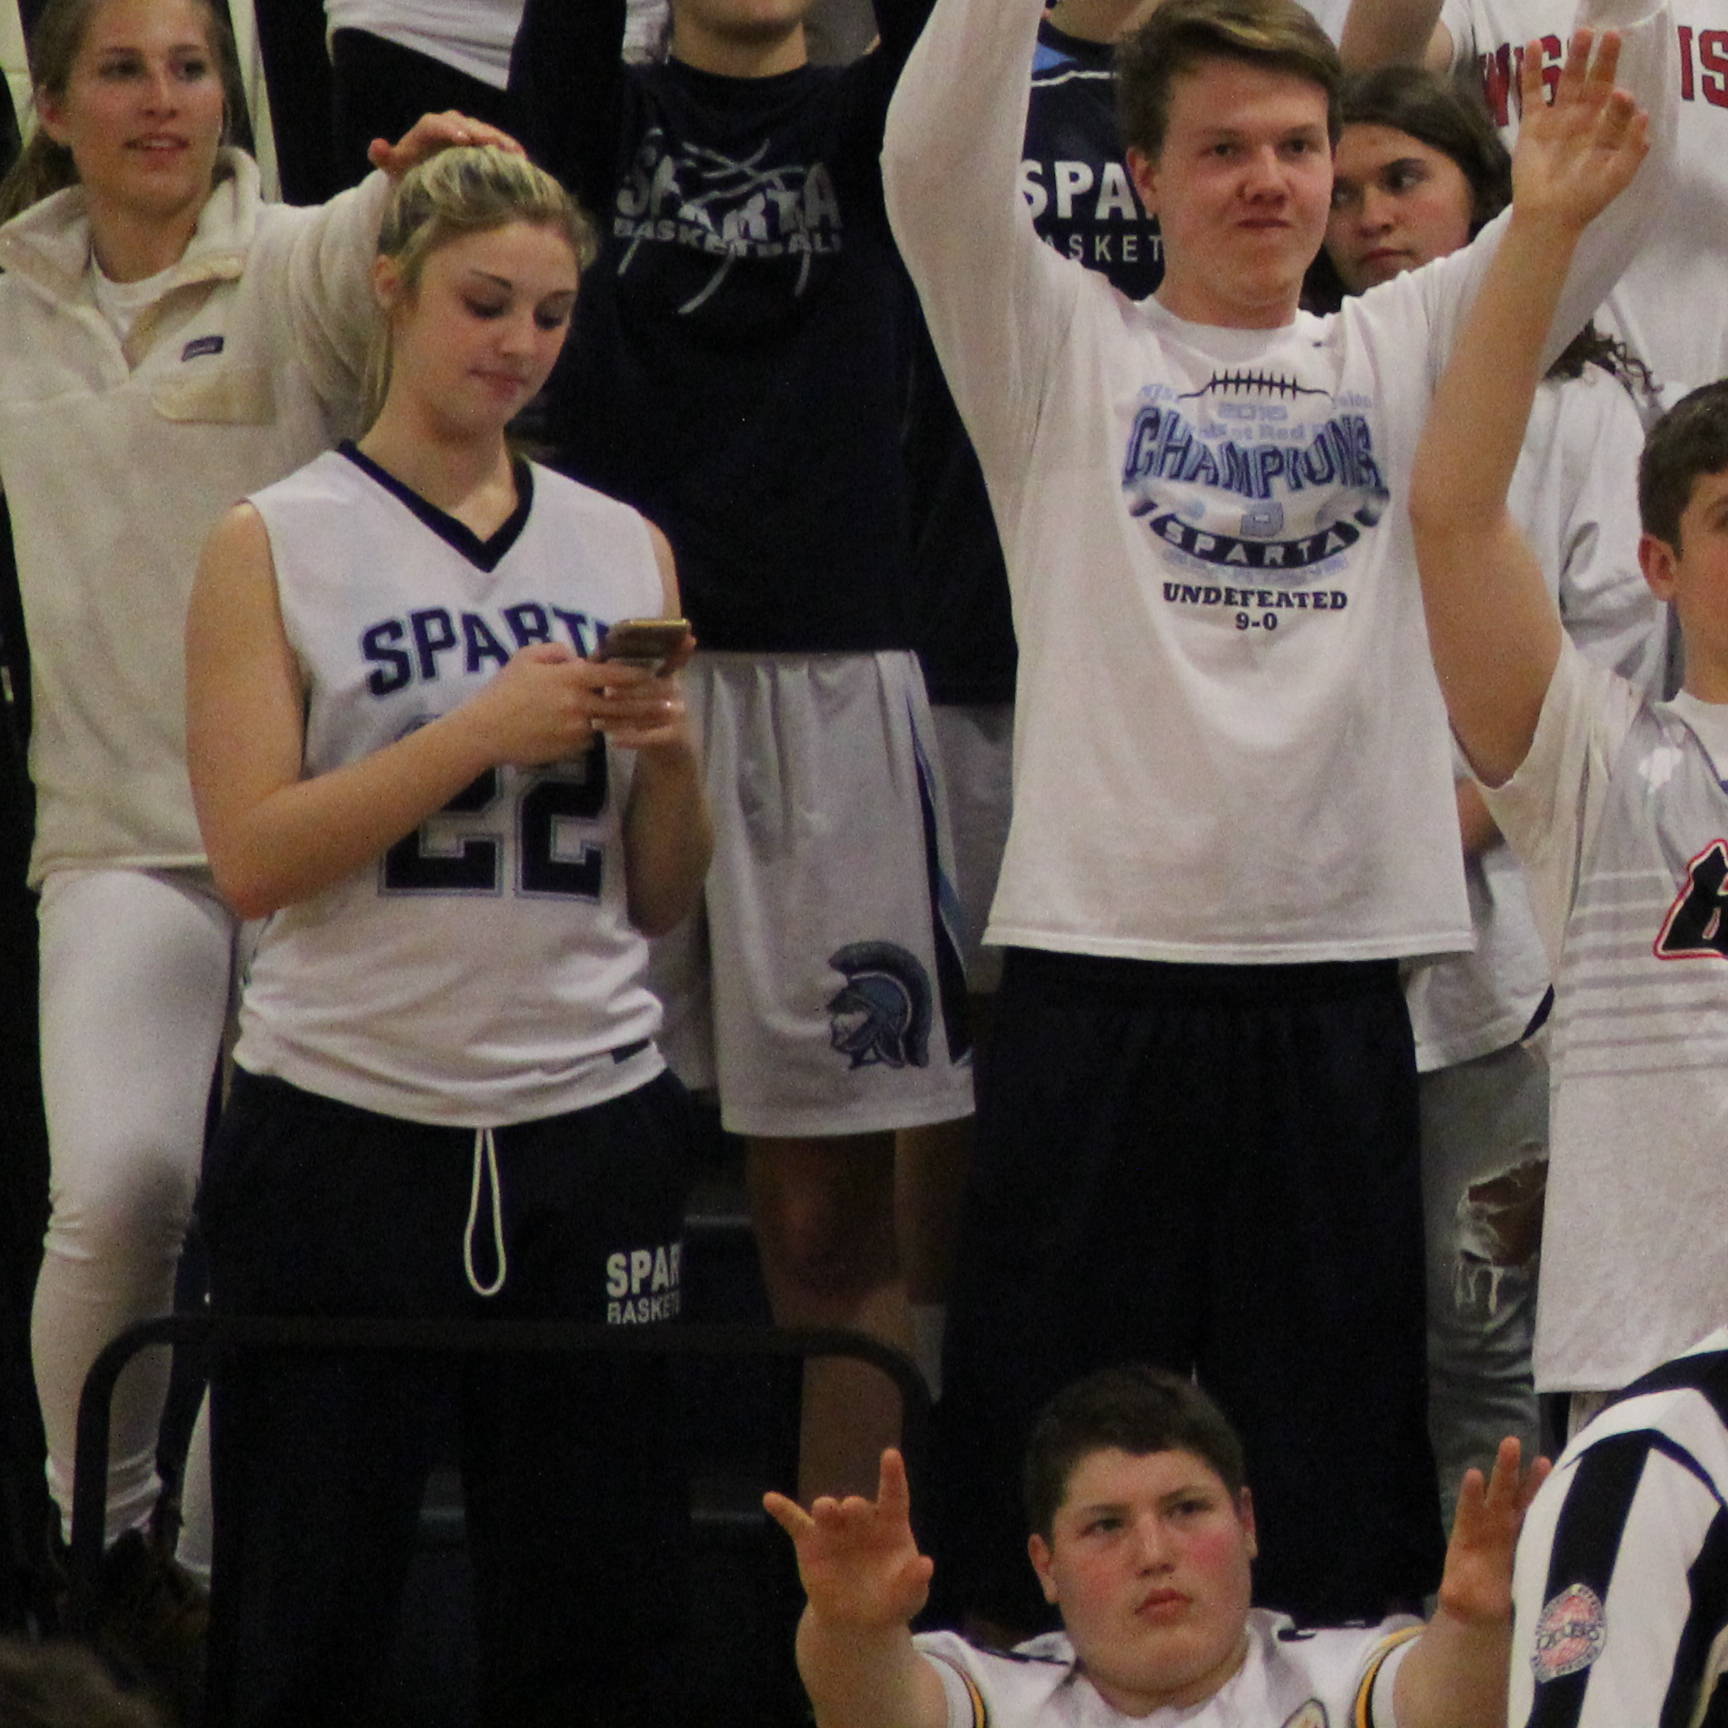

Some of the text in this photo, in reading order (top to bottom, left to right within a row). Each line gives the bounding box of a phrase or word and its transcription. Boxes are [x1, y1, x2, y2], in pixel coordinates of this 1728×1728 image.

[1021, 158, 1155, 219] SPA
[1044, 233, 1161, 263] ASKET
[1163, 519, 1347, 566] SPARTA
[1162, 581, 1348, 611] UNDEFEATED
[1235, 612, 1278, 632] 9-0
[361, 602, 610, 696] SPART
